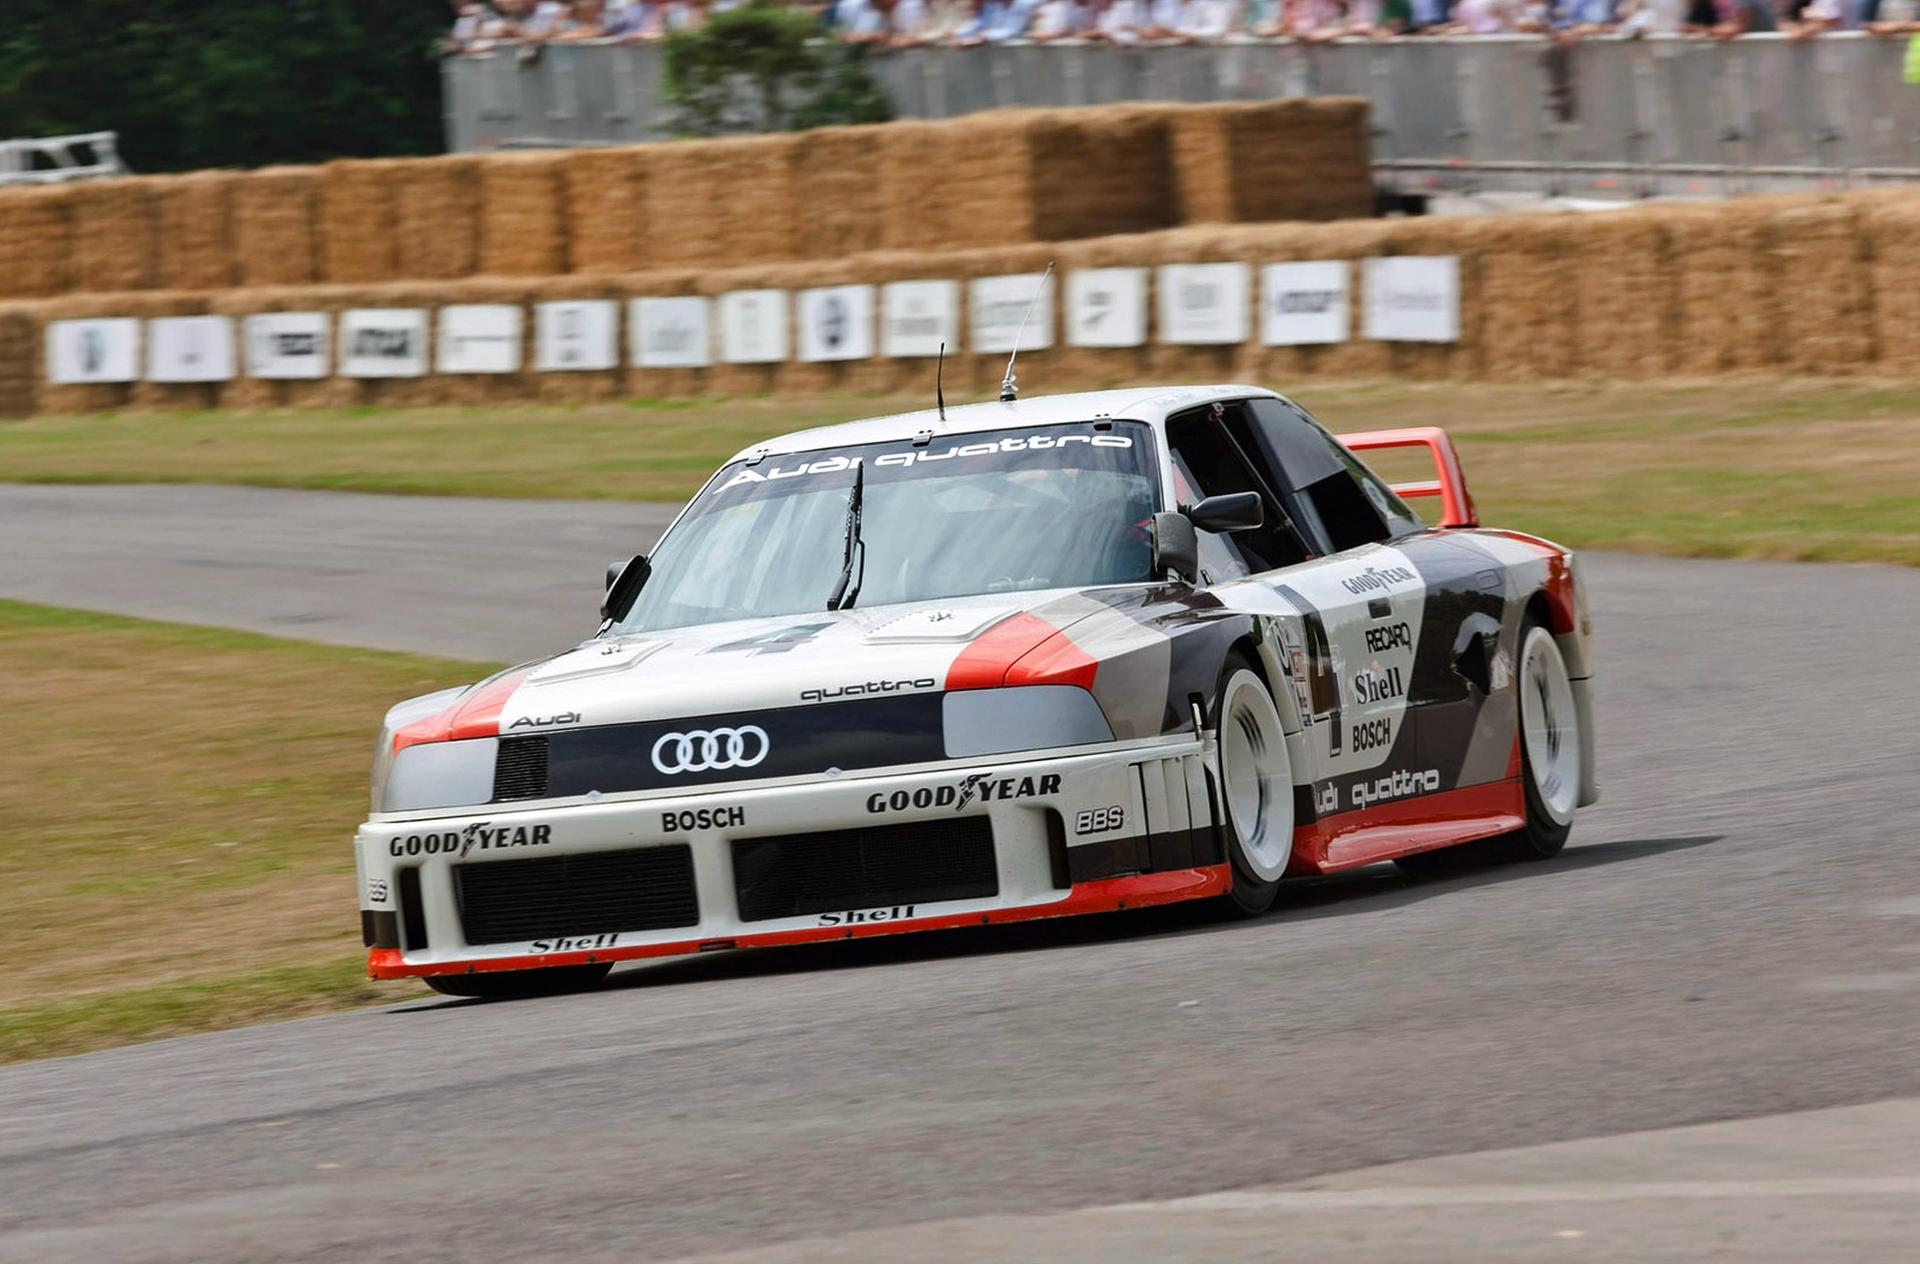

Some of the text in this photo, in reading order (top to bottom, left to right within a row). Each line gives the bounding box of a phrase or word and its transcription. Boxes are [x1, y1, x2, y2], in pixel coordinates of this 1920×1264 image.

[712, 435, 1133, 495] Audi quattro
[1365, 621, 1413, 655] RECARO
[801, 677, 936, 702] quattro
[1355, 667, 1404, 704] Shell
[509, 712, 582, 728] Audi
[1352, 717, 1391, 752] BOSCH
[1314, 769, 1440, 815] udi quattro
[662, 806, 745, 832] BOSCH
[1075, 805, 1124, 835] BBS
[817, 904, 916, 927] Shell
[528, 934, 619, 954] Shell
